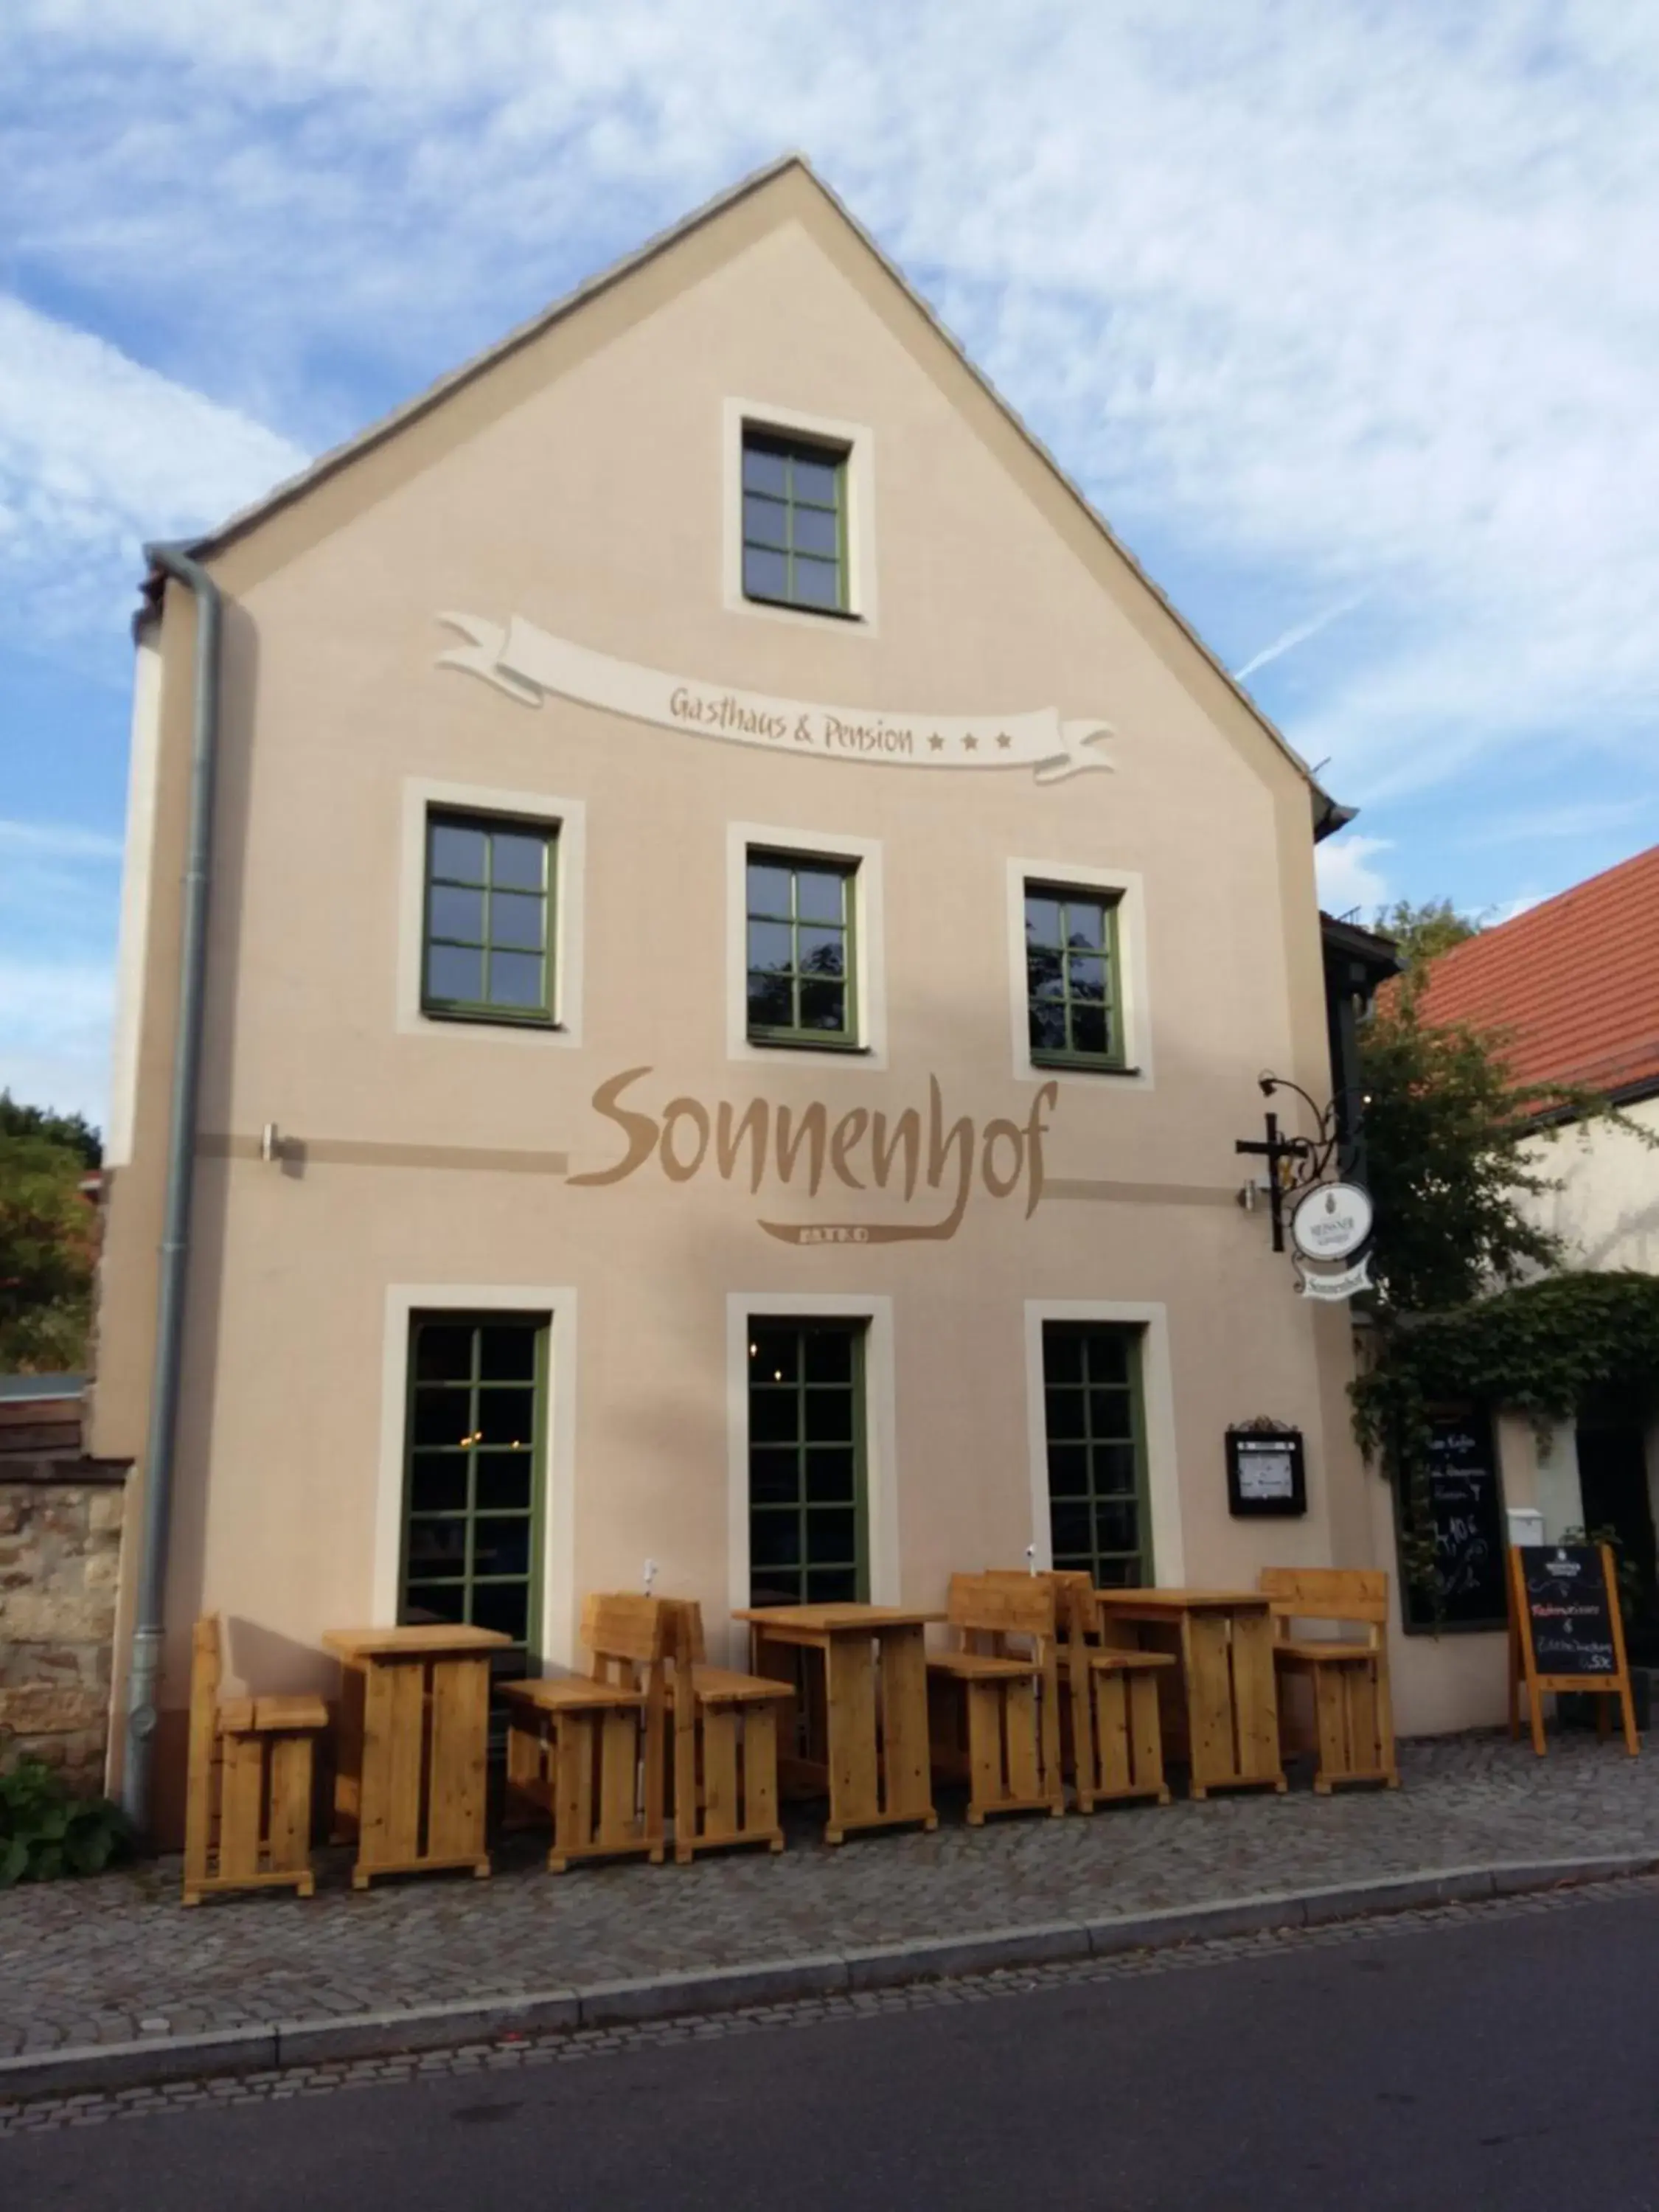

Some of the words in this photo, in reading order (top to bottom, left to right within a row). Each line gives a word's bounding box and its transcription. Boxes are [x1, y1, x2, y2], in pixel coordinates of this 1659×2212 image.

[669, 687, 787, 739] Gasthaus
[793, 714, 814, 745] &
[824, 714, 914, 755] Pension
[564, 1065, 1059, 1244] Sonnenhof
